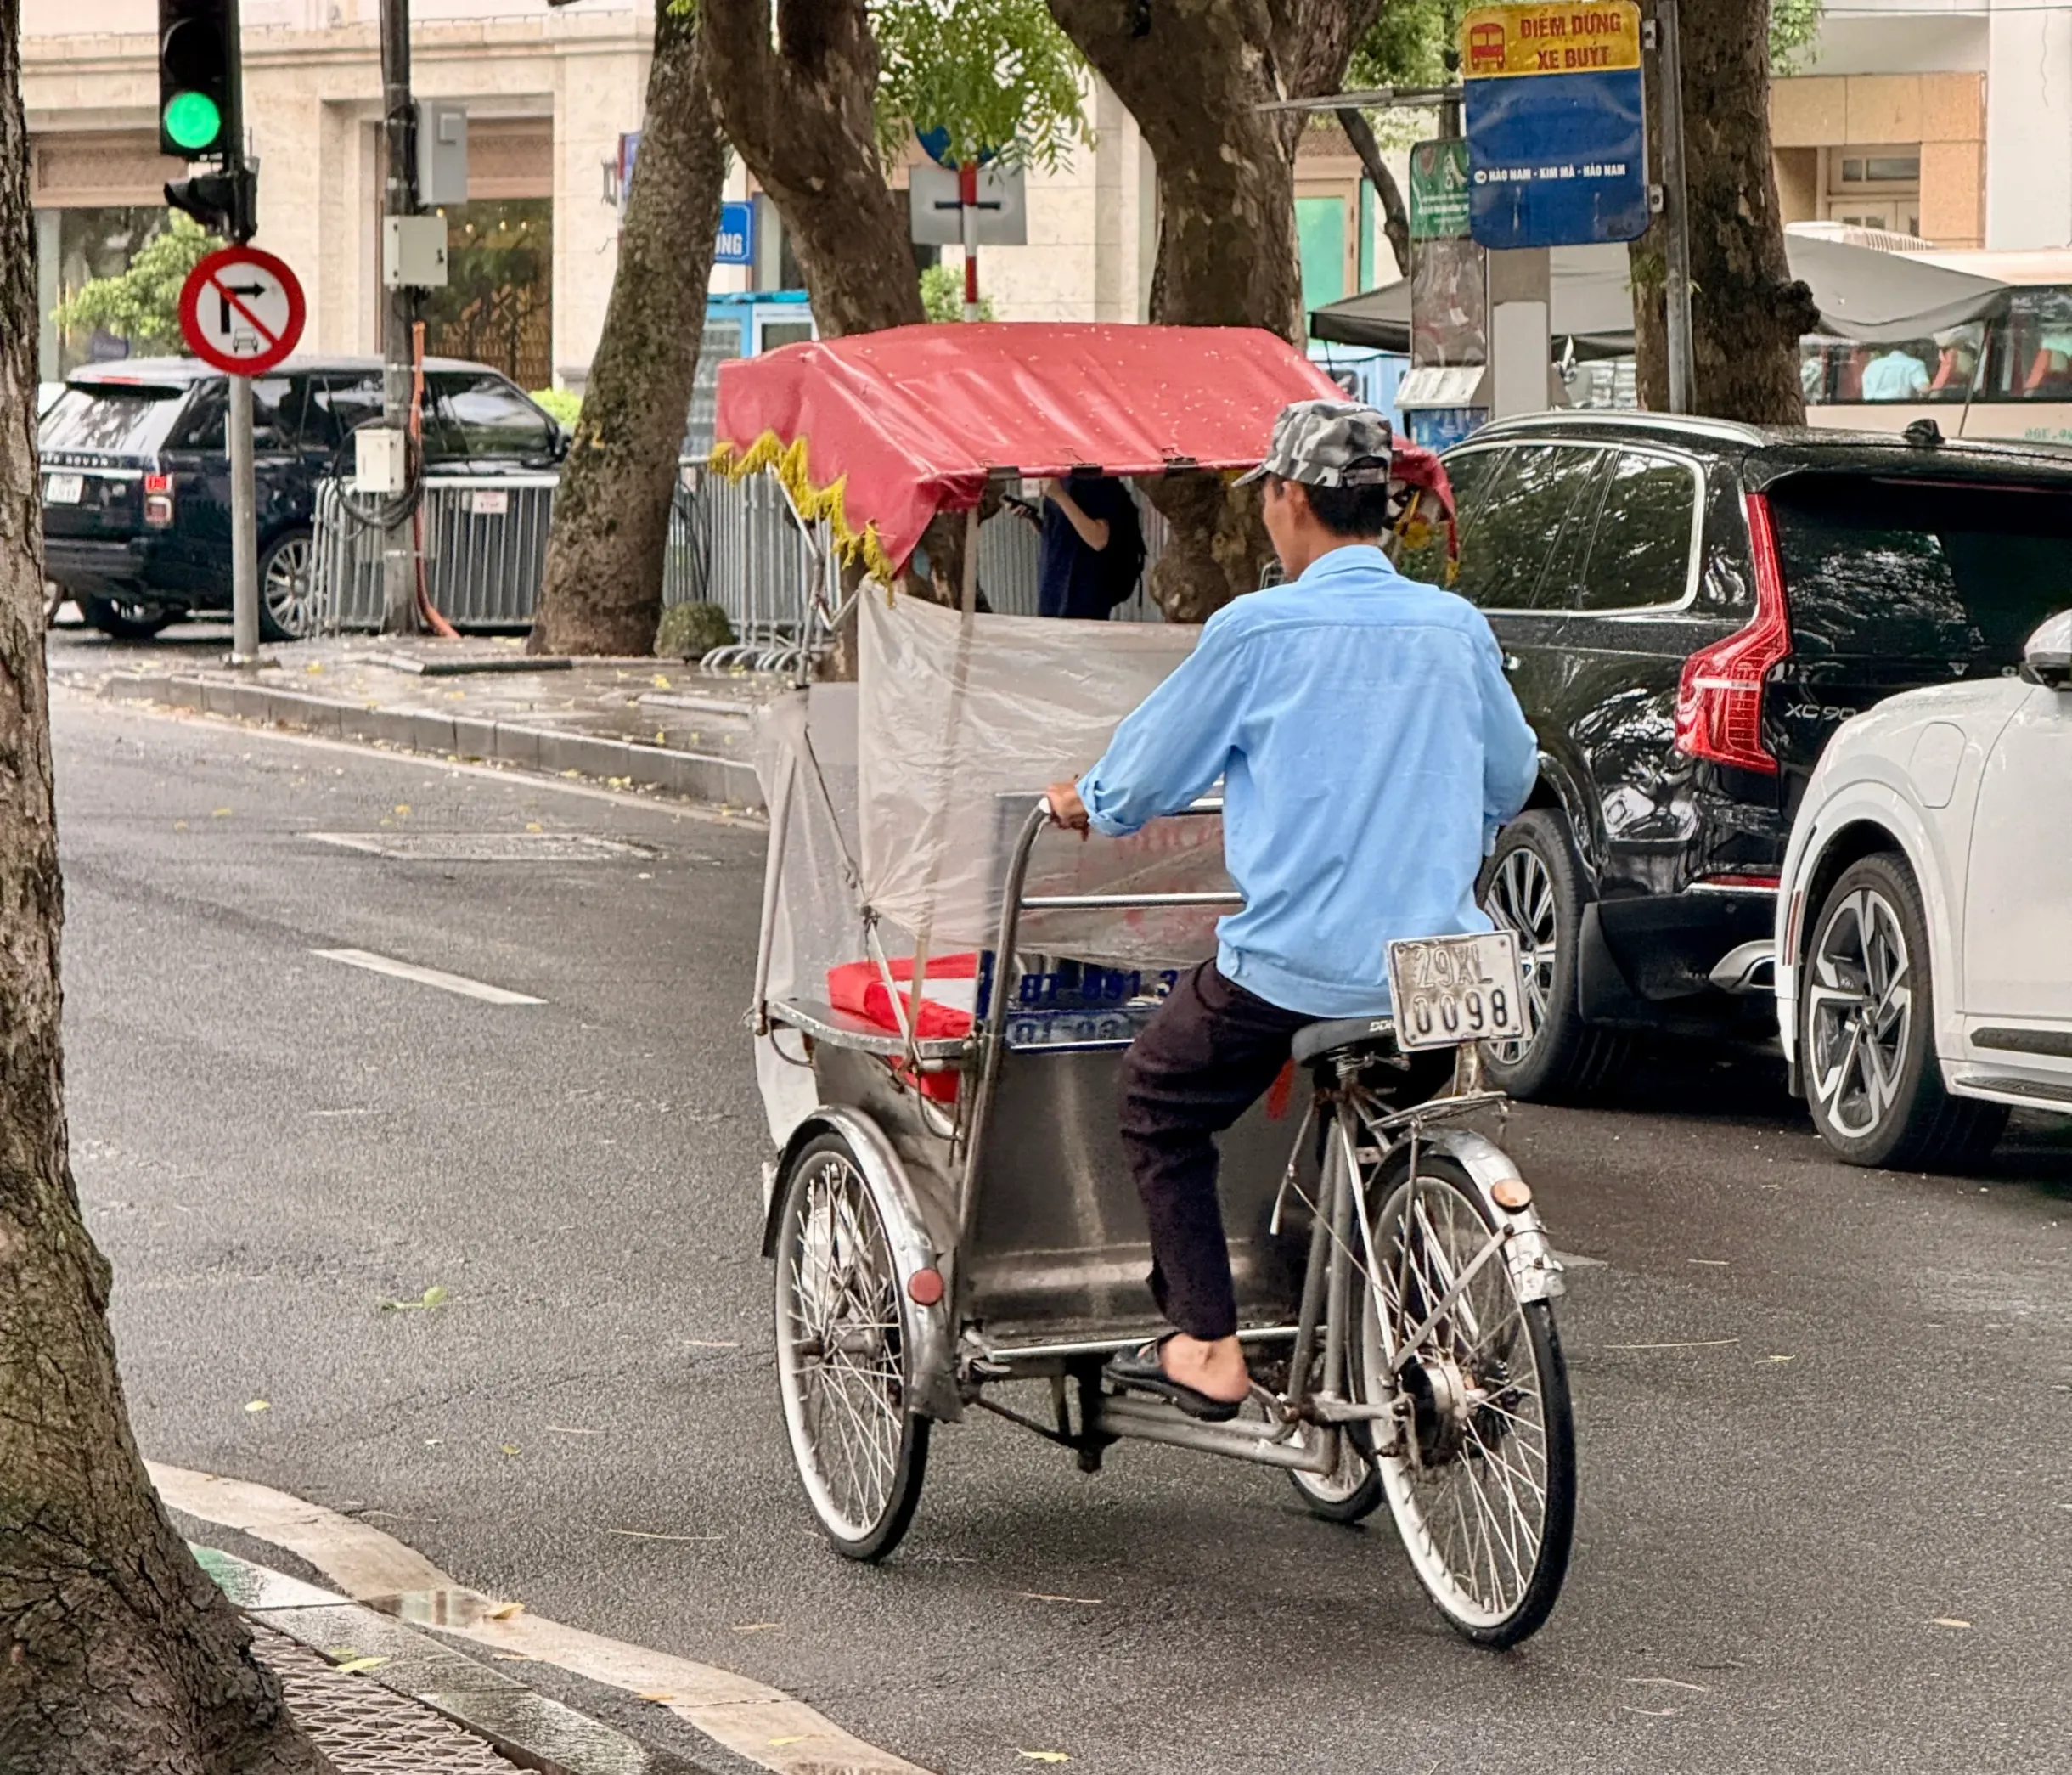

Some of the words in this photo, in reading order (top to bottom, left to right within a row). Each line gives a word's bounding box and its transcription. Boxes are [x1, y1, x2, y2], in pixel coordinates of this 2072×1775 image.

[1537, 49, 1559, 70] XE
[1565, 41, 1609, 68] BUÝT
[1784, 702, 1856, 722] XC90
[1415, 944, 1493, 989] 29XL
[1413, 989, 1508, 1034] 0098
